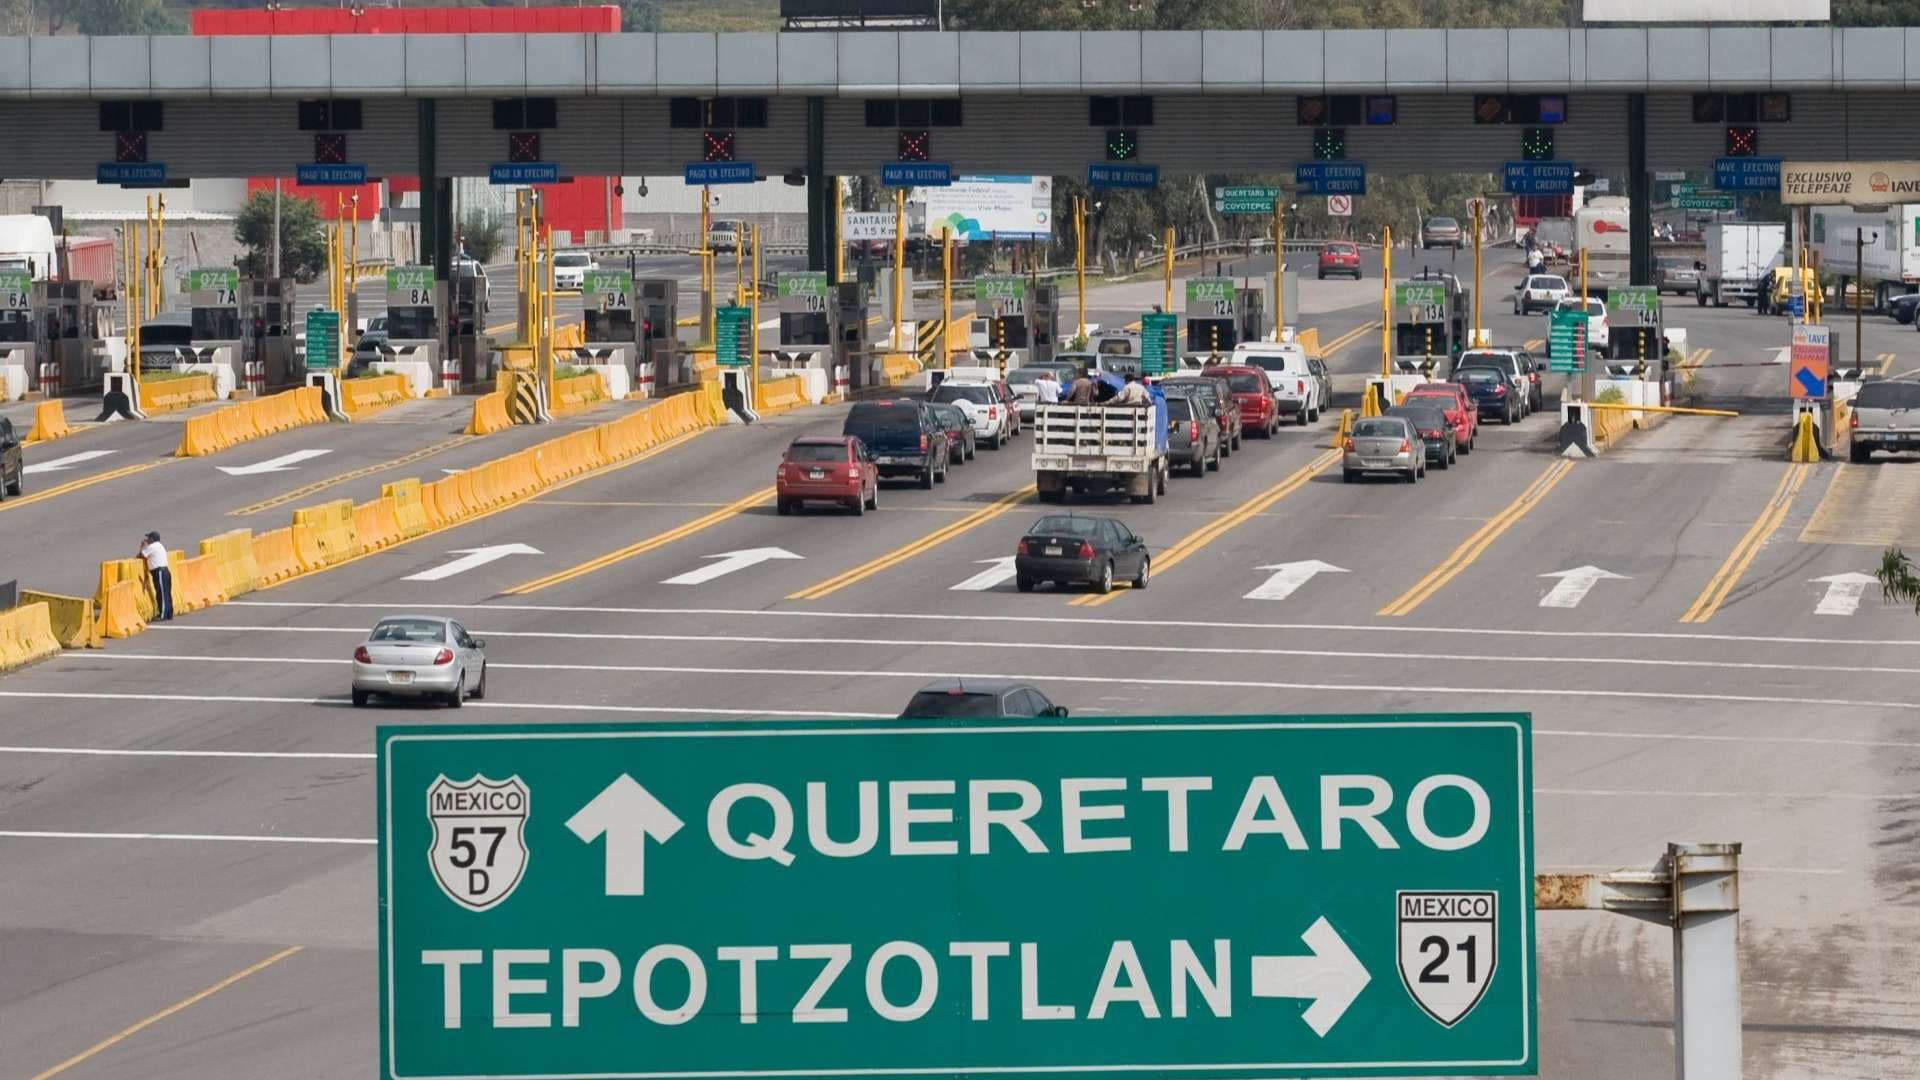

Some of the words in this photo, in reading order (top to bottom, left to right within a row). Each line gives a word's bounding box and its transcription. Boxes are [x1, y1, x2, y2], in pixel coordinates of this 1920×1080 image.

[1325, 167, 1361, 176] EFECTIVO
[1533, 167, 1569, 177] EFECTIVO
[1786, 172, 1852, 183] EXCLUSIVO
[1536, 180, 1567, 190] CREDITO
[1787, 183, 1852, 193] TELEPEAJE
[847, 216, 897, 225] SANITARIO
[200, 272, 227, 287] 074
[397, 272, 424, 285] 074
[593, 276, 621, 289] 074
[789, 279, 817, 291] 074
[986, 281, 1013, 293] 074
[1196, 283, 1223, 296] 074
[1406, 288, 1434, 300] 074
[1619, 292, 1646, 304] 074
[436, 792, 522, 811] MEXICO
[707, 774, 1491, 866] QUERETARO
[449, 826, 507, 869] 57
[468, 868, 490, 896] D
[1405, 898, 1489, 917] MEXICO
[1418, 935, 1476, 984] 21
[421, 939, 1232, 1029] TEPOTZOTLAN
